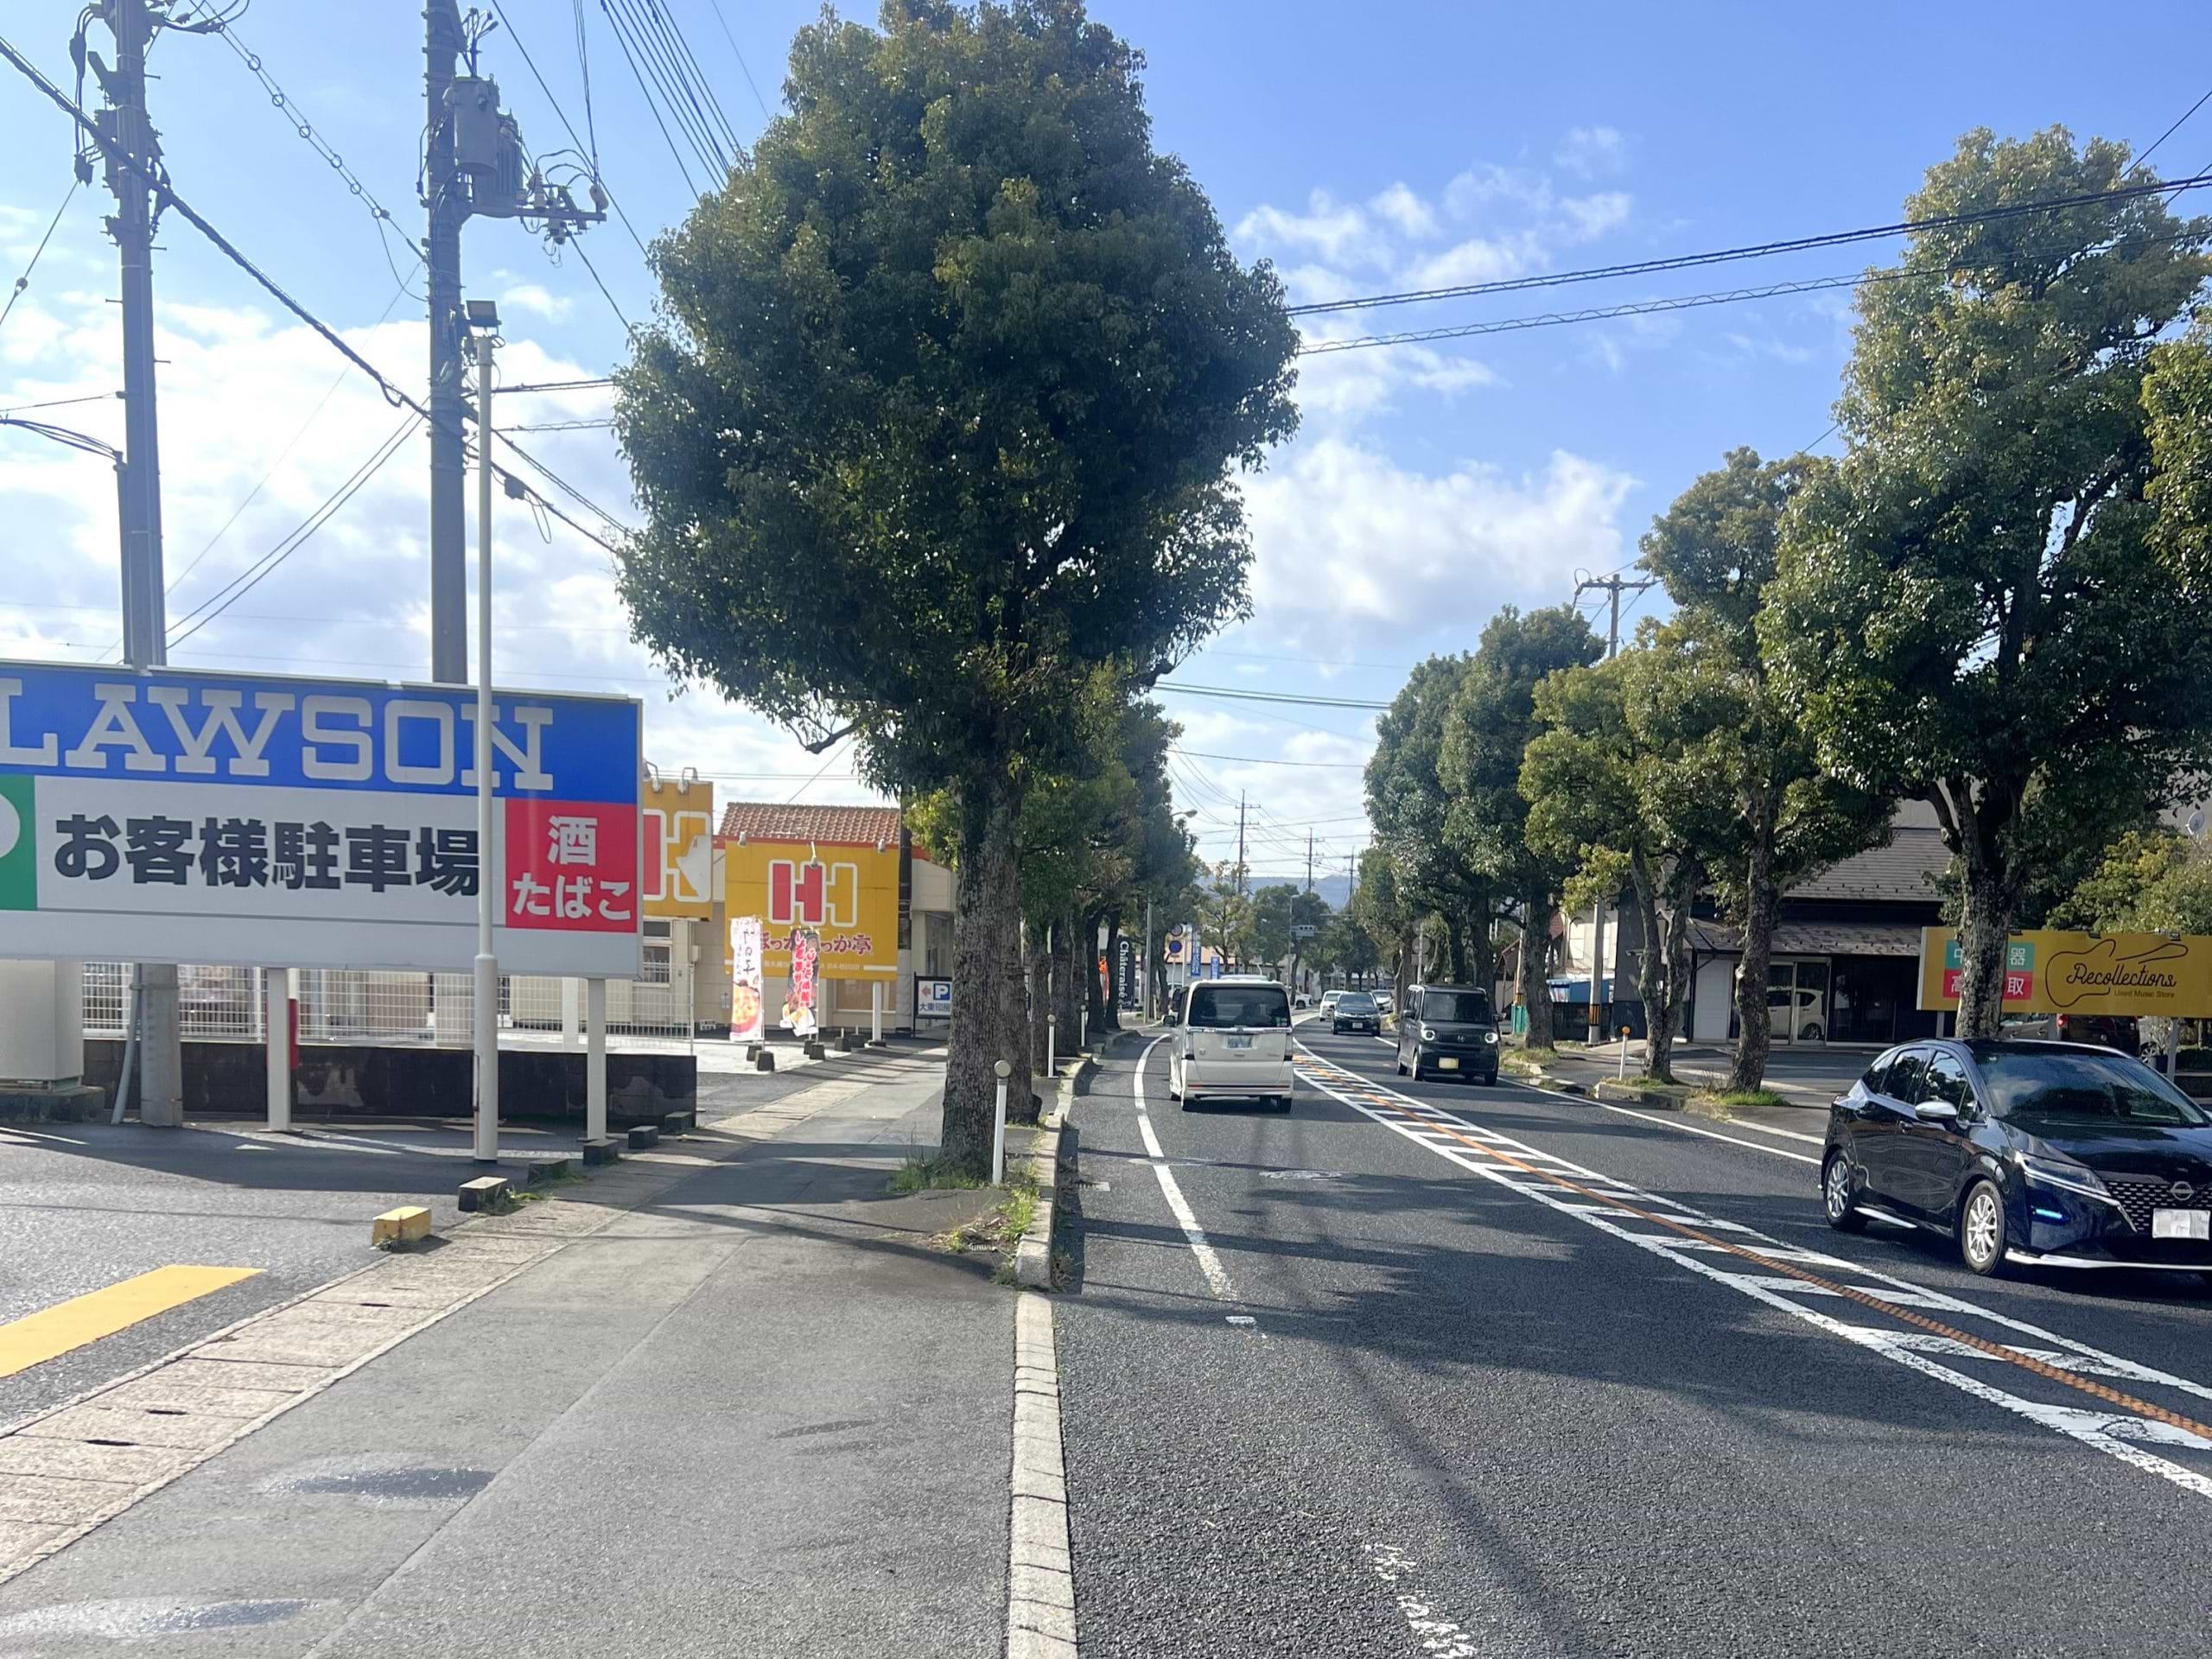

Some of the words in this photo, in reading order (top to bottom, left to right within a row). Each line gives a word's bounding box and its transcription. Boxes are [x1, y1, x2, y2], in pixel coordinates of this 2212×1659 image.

[0, 677, 554, 791] LAWSON
[54, 814, 480, 897] お客様駐車場
[547, 815, 598, 866] 酒
[512, 872, 631, 920] たばこ
[935, 985, 949, 999] P
[1951, 976, 2024, 995] 高取
[2066, 963, 2177, 987] Recollections
